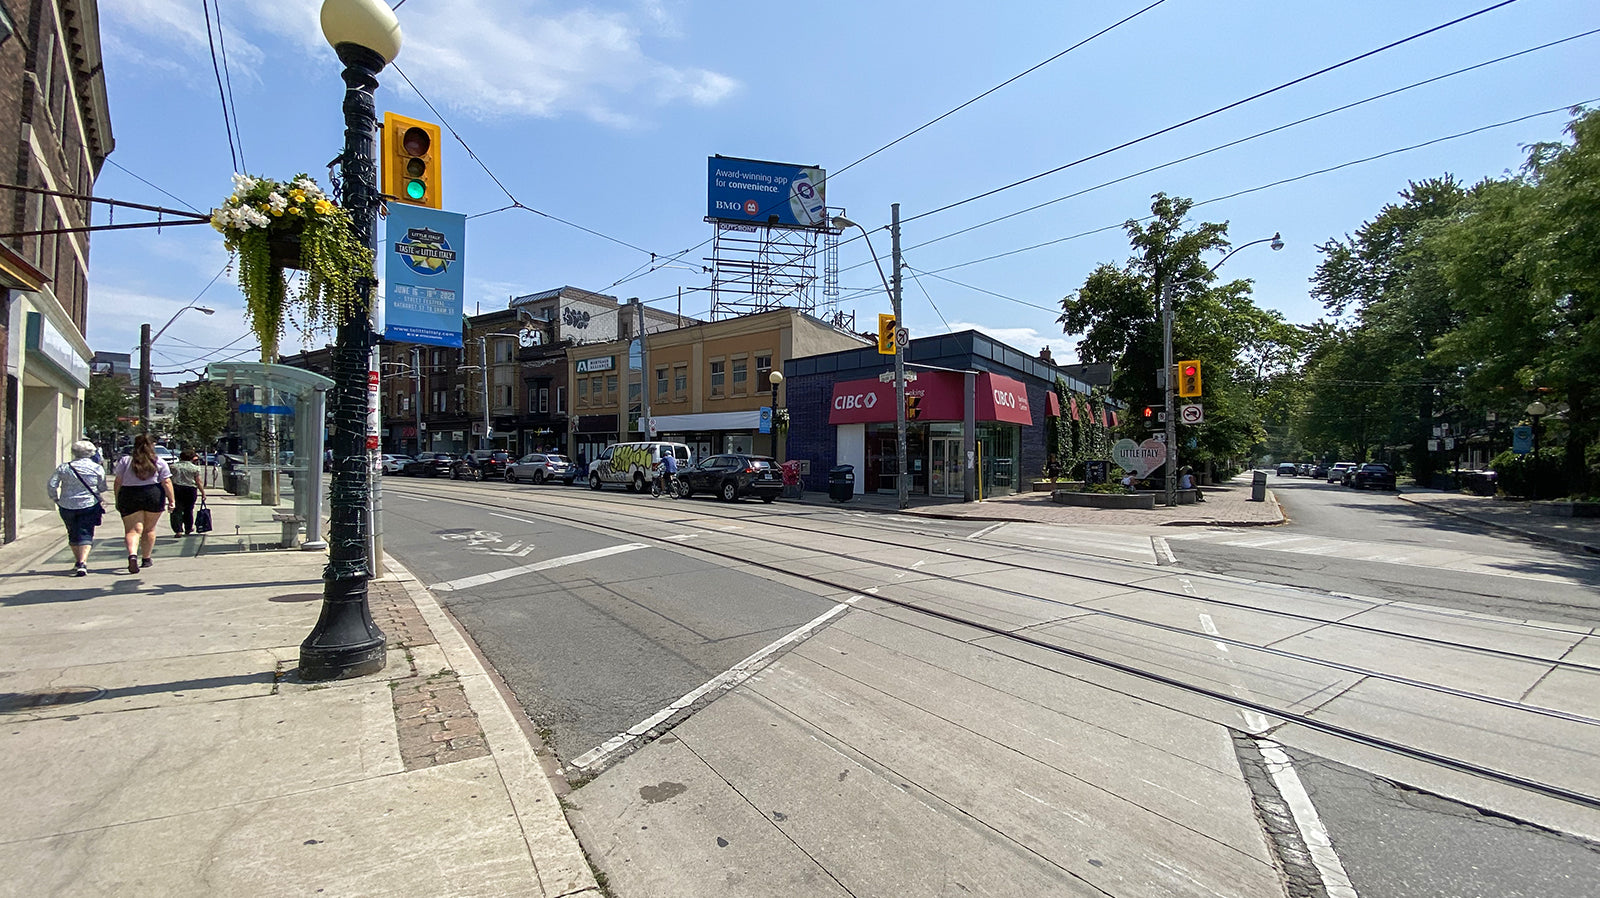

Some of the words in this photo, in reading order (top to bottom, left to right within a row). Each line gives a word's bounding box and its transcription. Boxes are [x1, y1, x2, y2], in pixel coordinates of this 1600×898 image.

[716, 169, 771, 184] Award-winning
[774, 176, 788, 185] app
[716, 178, 726, 187] for
[729, 181, 779, 193] convenience.
[716, 201, 741, 211] BMO
[399, 245, 414, 254] TASTE
[421, 248, 438, 257] LITTLE
[439, 251, 453, 259] ITALY
[394, 285, 409, 294] JUNE
[440, 291, 455, 300] 2023
[834, 394, 863, 409] CIBC
[994, 389, 1009, 407] CIBC
[1120, 449, 1140, 458] LITTLE
[1141, 449, 1159, 458] ITALY
